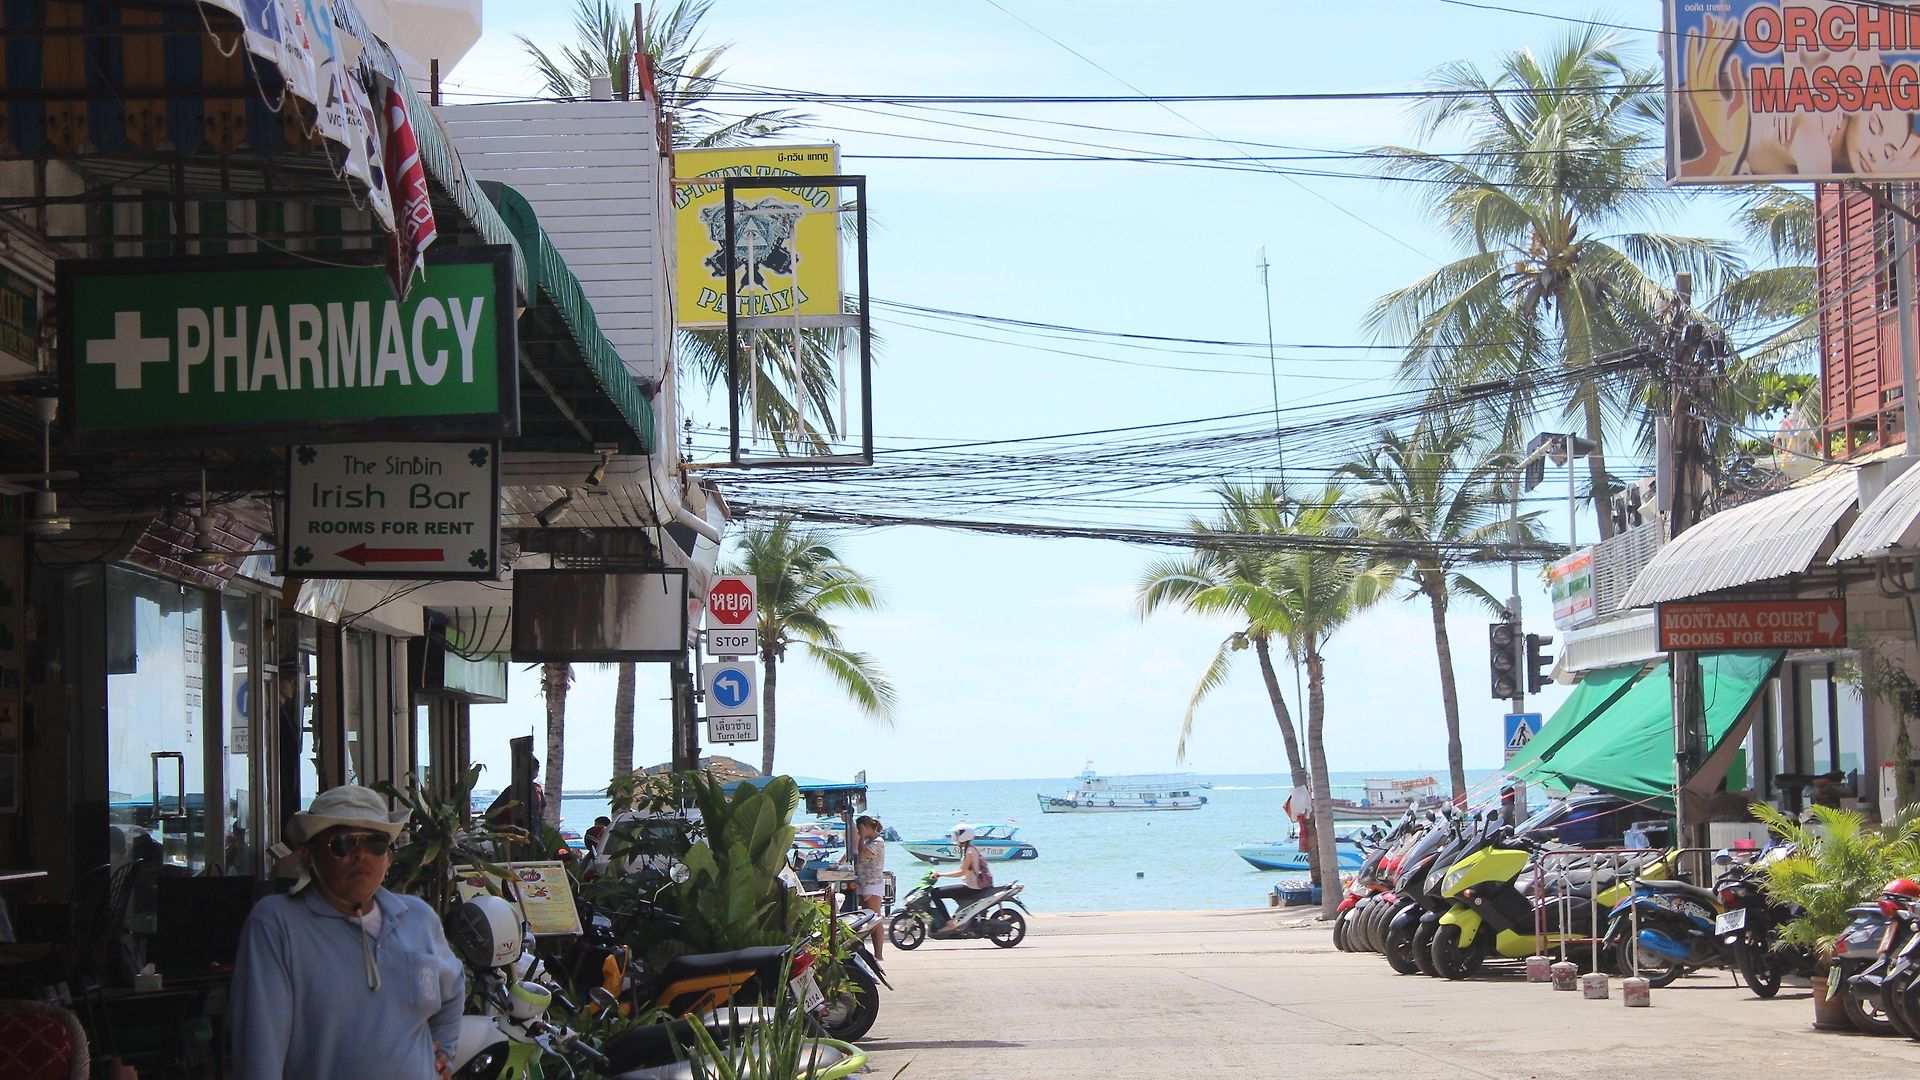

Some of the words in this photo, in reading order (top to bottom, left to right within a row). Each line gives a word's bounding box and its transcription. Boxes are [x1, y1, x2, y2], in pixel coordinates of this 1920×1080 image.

[1751, 64, 1920, 113] MASSAG
[697, 286, 808, 315] PATTAYA
[177, 296, 484, 394] PHARMACY
[343, 455, 376, 475] The
[385, 456, 442, 475] SinBin
[313, 482, 385, 508] Irish
[409, 483, 470, 509] Bar
[308, 521, 375, 534] ROOMS
[381, 521, 418, 534] FOR
[424, 521, 474, 535] RENT
[711, 593, 751, 618] หยุด
[1665, 612, 1750, 629] MONTANA
[1757, 611, 1816, 627] COURT
[716, 636, 749, 647] STOP
[1669, 633, 1724, 645] ROOMS
[1733, 632, 1764, 644] FOR
[1772, 631, 1814, 643] RENT
[717, 732, 735, 740] Turn
[737, 731, 751, 740] left
